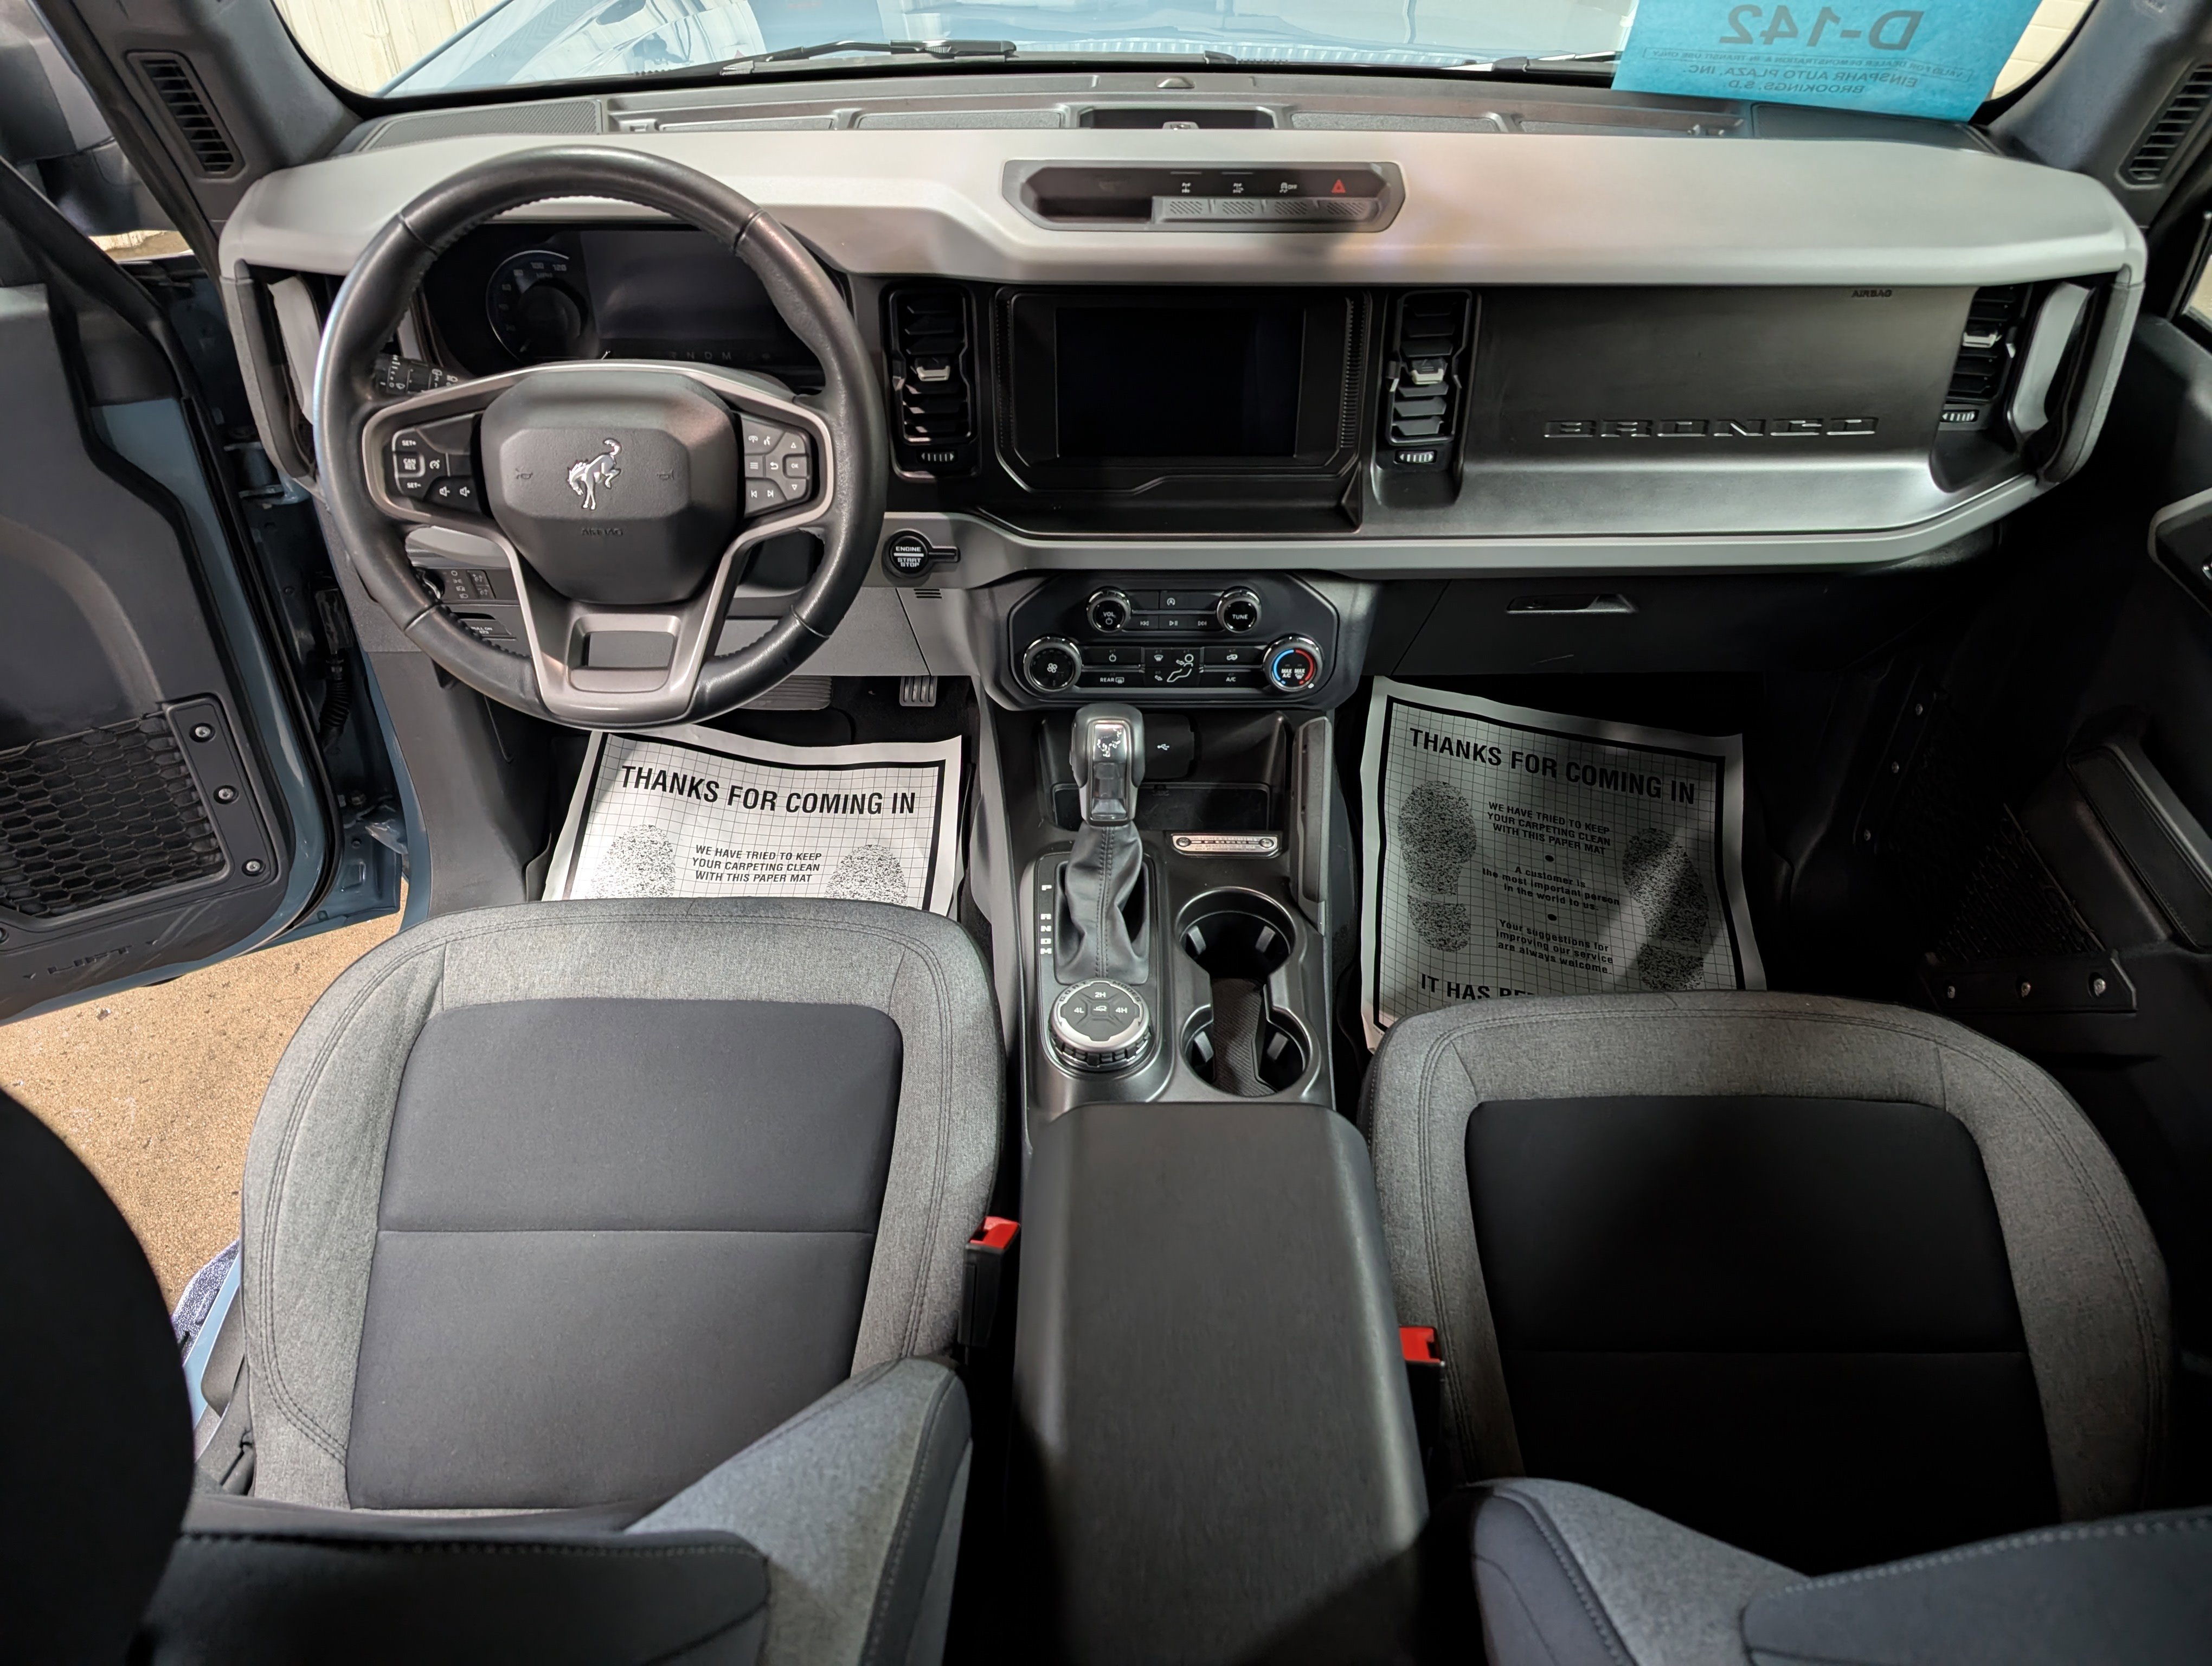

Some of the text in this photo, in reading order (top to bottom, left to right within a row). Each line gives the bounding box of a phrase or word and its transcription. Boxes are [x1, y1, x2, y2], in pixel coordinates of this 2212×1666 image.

[1851, 289, 1892, 298] AIRBAG
[686, 351, 695, 360] N
[722, 351, 731, 360] M
[1545, 418, 1878, 437] BRONCO
[1410, 728, 1695, 805] THANKS FOR COMING IN
[622, 766, 916, 815] THANKS FOR COMING IN
[1487, 812, 1611, 846] YOUR CARPETING CLEAN
[1488, 802, 1610, 835] WE HAVE TRIED TO KEEP
[696, 845, 822, 861] WE HAVE TRIED TO KEEP
[1493, 823, 1606, 855] WITH THIS PAPER MAT
[692, 857, 820, 872] YOUR CARPETING CLEAN
[696, 871, 812, 882] WITH THIS PAPER MAT
[1515, 866, 1586, 888] A customer is
[1482, 868, 1620, 906] the most important person
[1504, 883, 1599, 911] in the world to us.
[1496, 928, 1613, 964] improving our service
[1498, 919, 1609, 952] Your suggestions for
[1498, 942, 1612, 975] are always welcome.
[1112, 981, 1142, 1002] MODES
[1422, 973, 1439, 992] IT
[1447, 982, 1490, 1001] HAS
